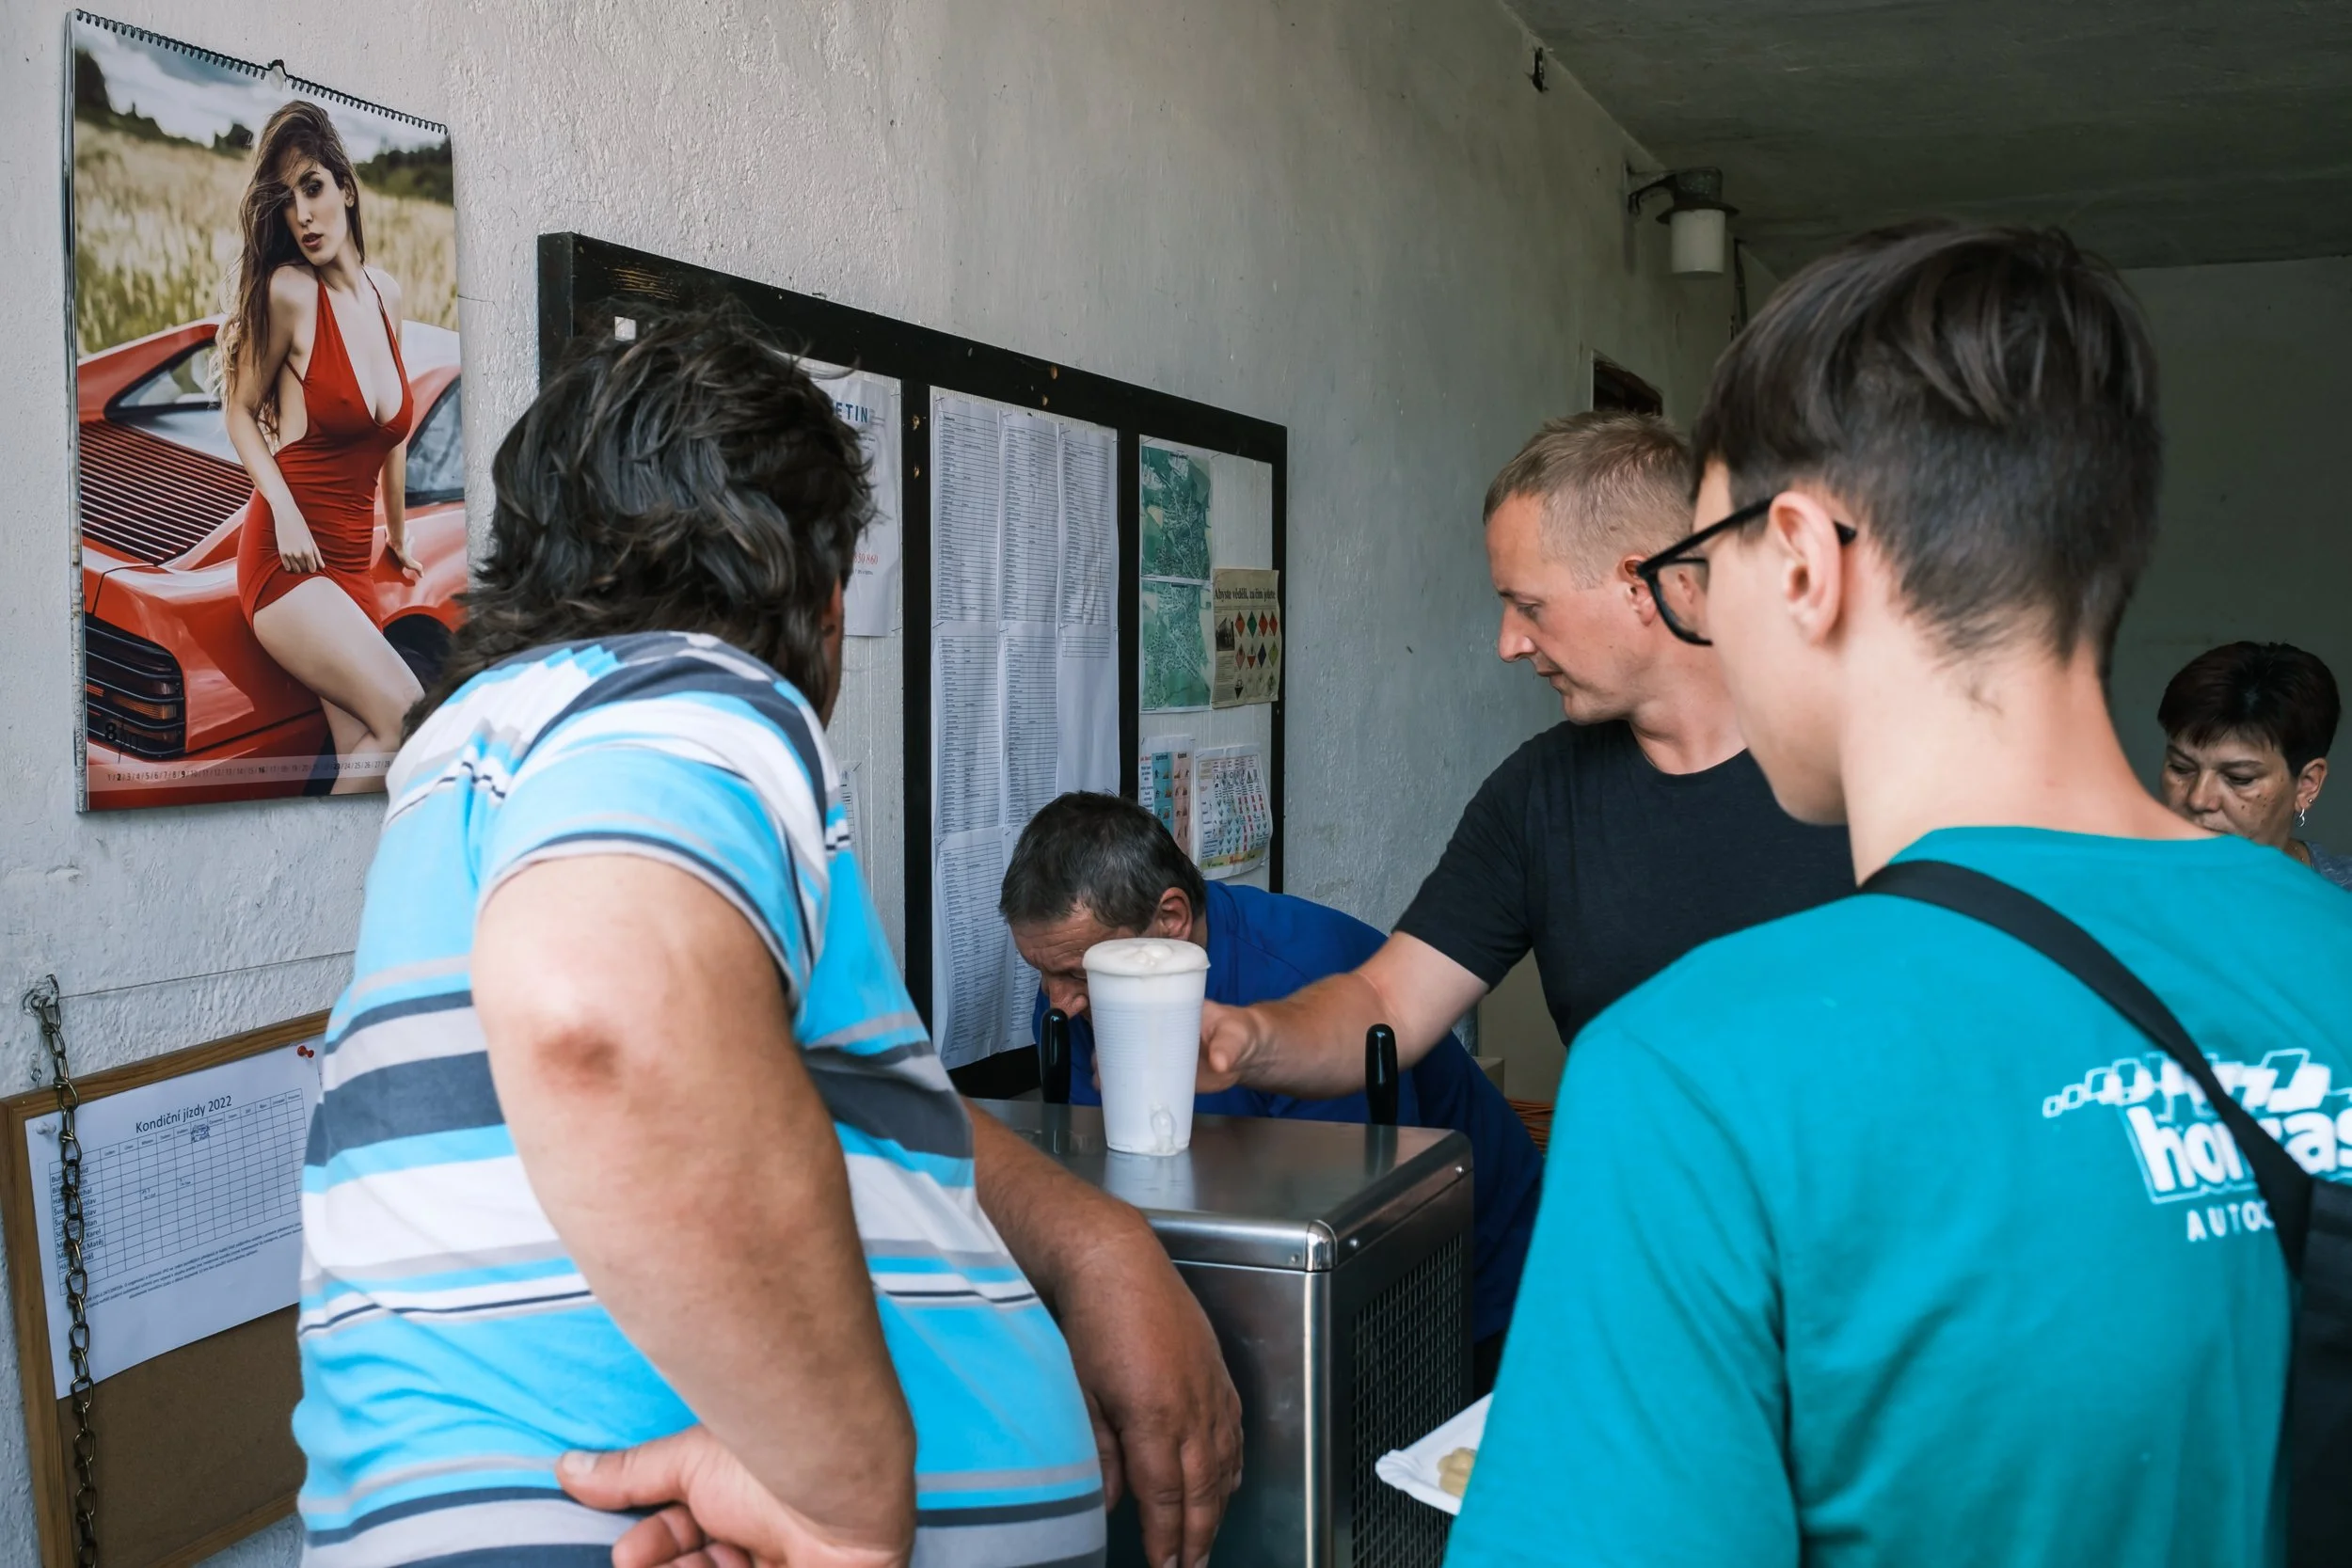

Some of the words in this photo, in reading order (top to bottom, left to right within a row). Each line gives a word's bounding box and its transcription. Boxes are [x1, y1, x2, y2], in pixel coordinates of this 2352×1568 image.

[832, 402, 868, 423] ETIN
[116, 773, 121, 782] 2
[333, 762, 341, 770] 23
[344, 762, 351, 770] 24
[354, 761, 361, 769] 25
[364, 761, 371, 769] 26
[374, 760, 381, 768] 27
[384, 759, 390, 768] 28
[135, 1110, 182, 1133] Kondiční
[183, 1103, 206, 1123] jízdy
[208, 1095, 232, 1112] 2022
[86, 1228, 102, 1239] Karel
[87, 1239, 104, 1250] Matěj
